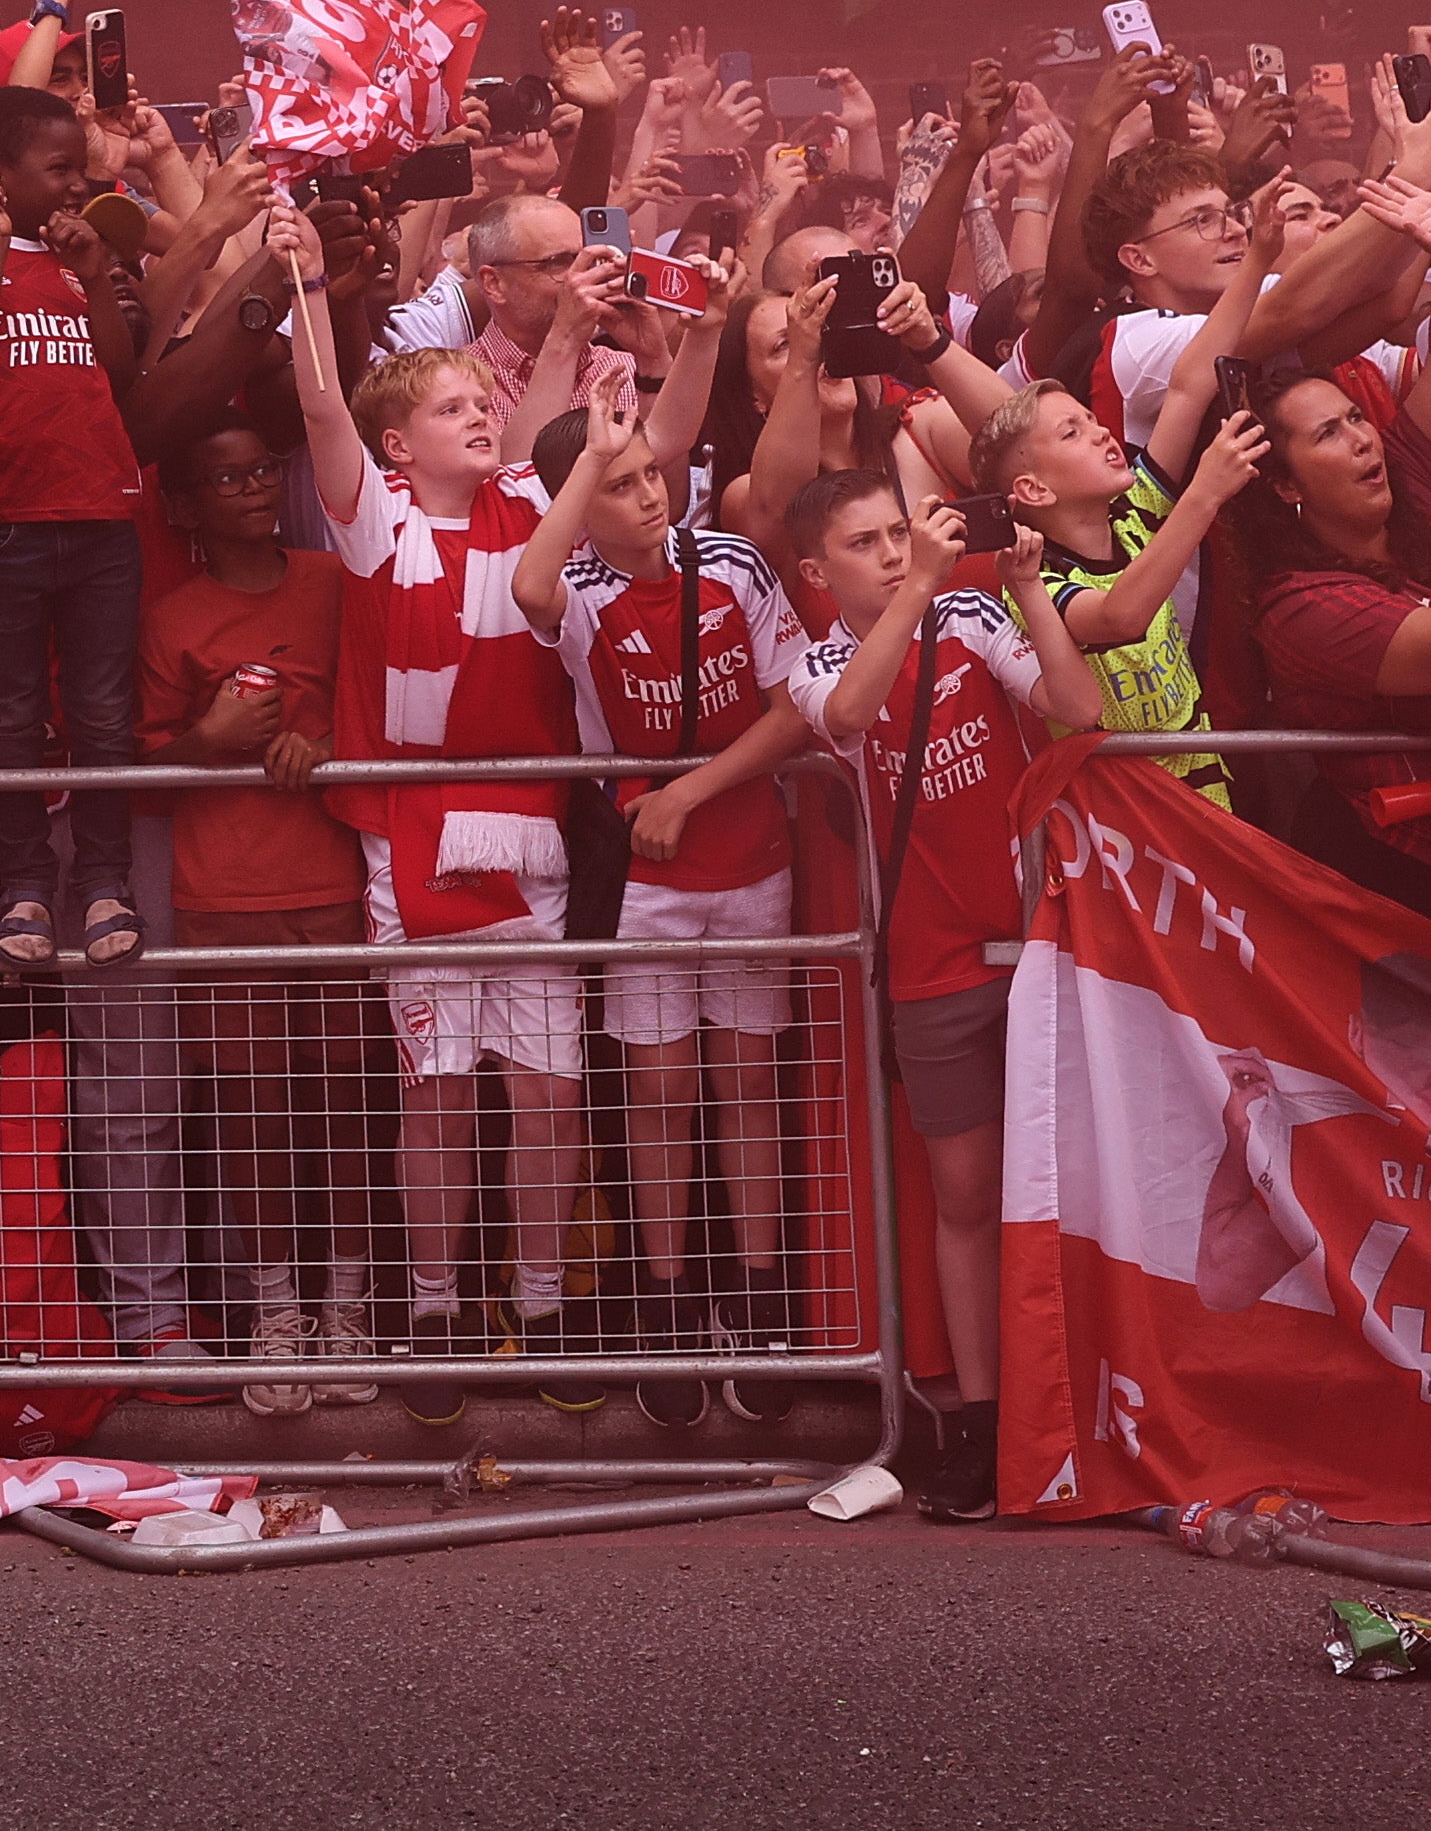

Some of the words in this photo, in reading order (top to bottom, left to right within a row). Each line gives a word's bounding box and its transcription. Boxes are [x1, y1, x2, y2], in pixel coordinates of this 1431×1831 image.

[9, 341, 40, 368] FLY
[46, 340, 97, 368] BETTE
[644, 707, 673, 731] FLY
[679, 679, 741, 722] TTER
[1139, 689, 1170, 727] FLY
[871, 714, 991, 774] Emrates
[921, 752, 989, 802] BETTER
[1011, 798, 1256, 975] ORTH
[1094, 1357, 1146, 1460] IS
